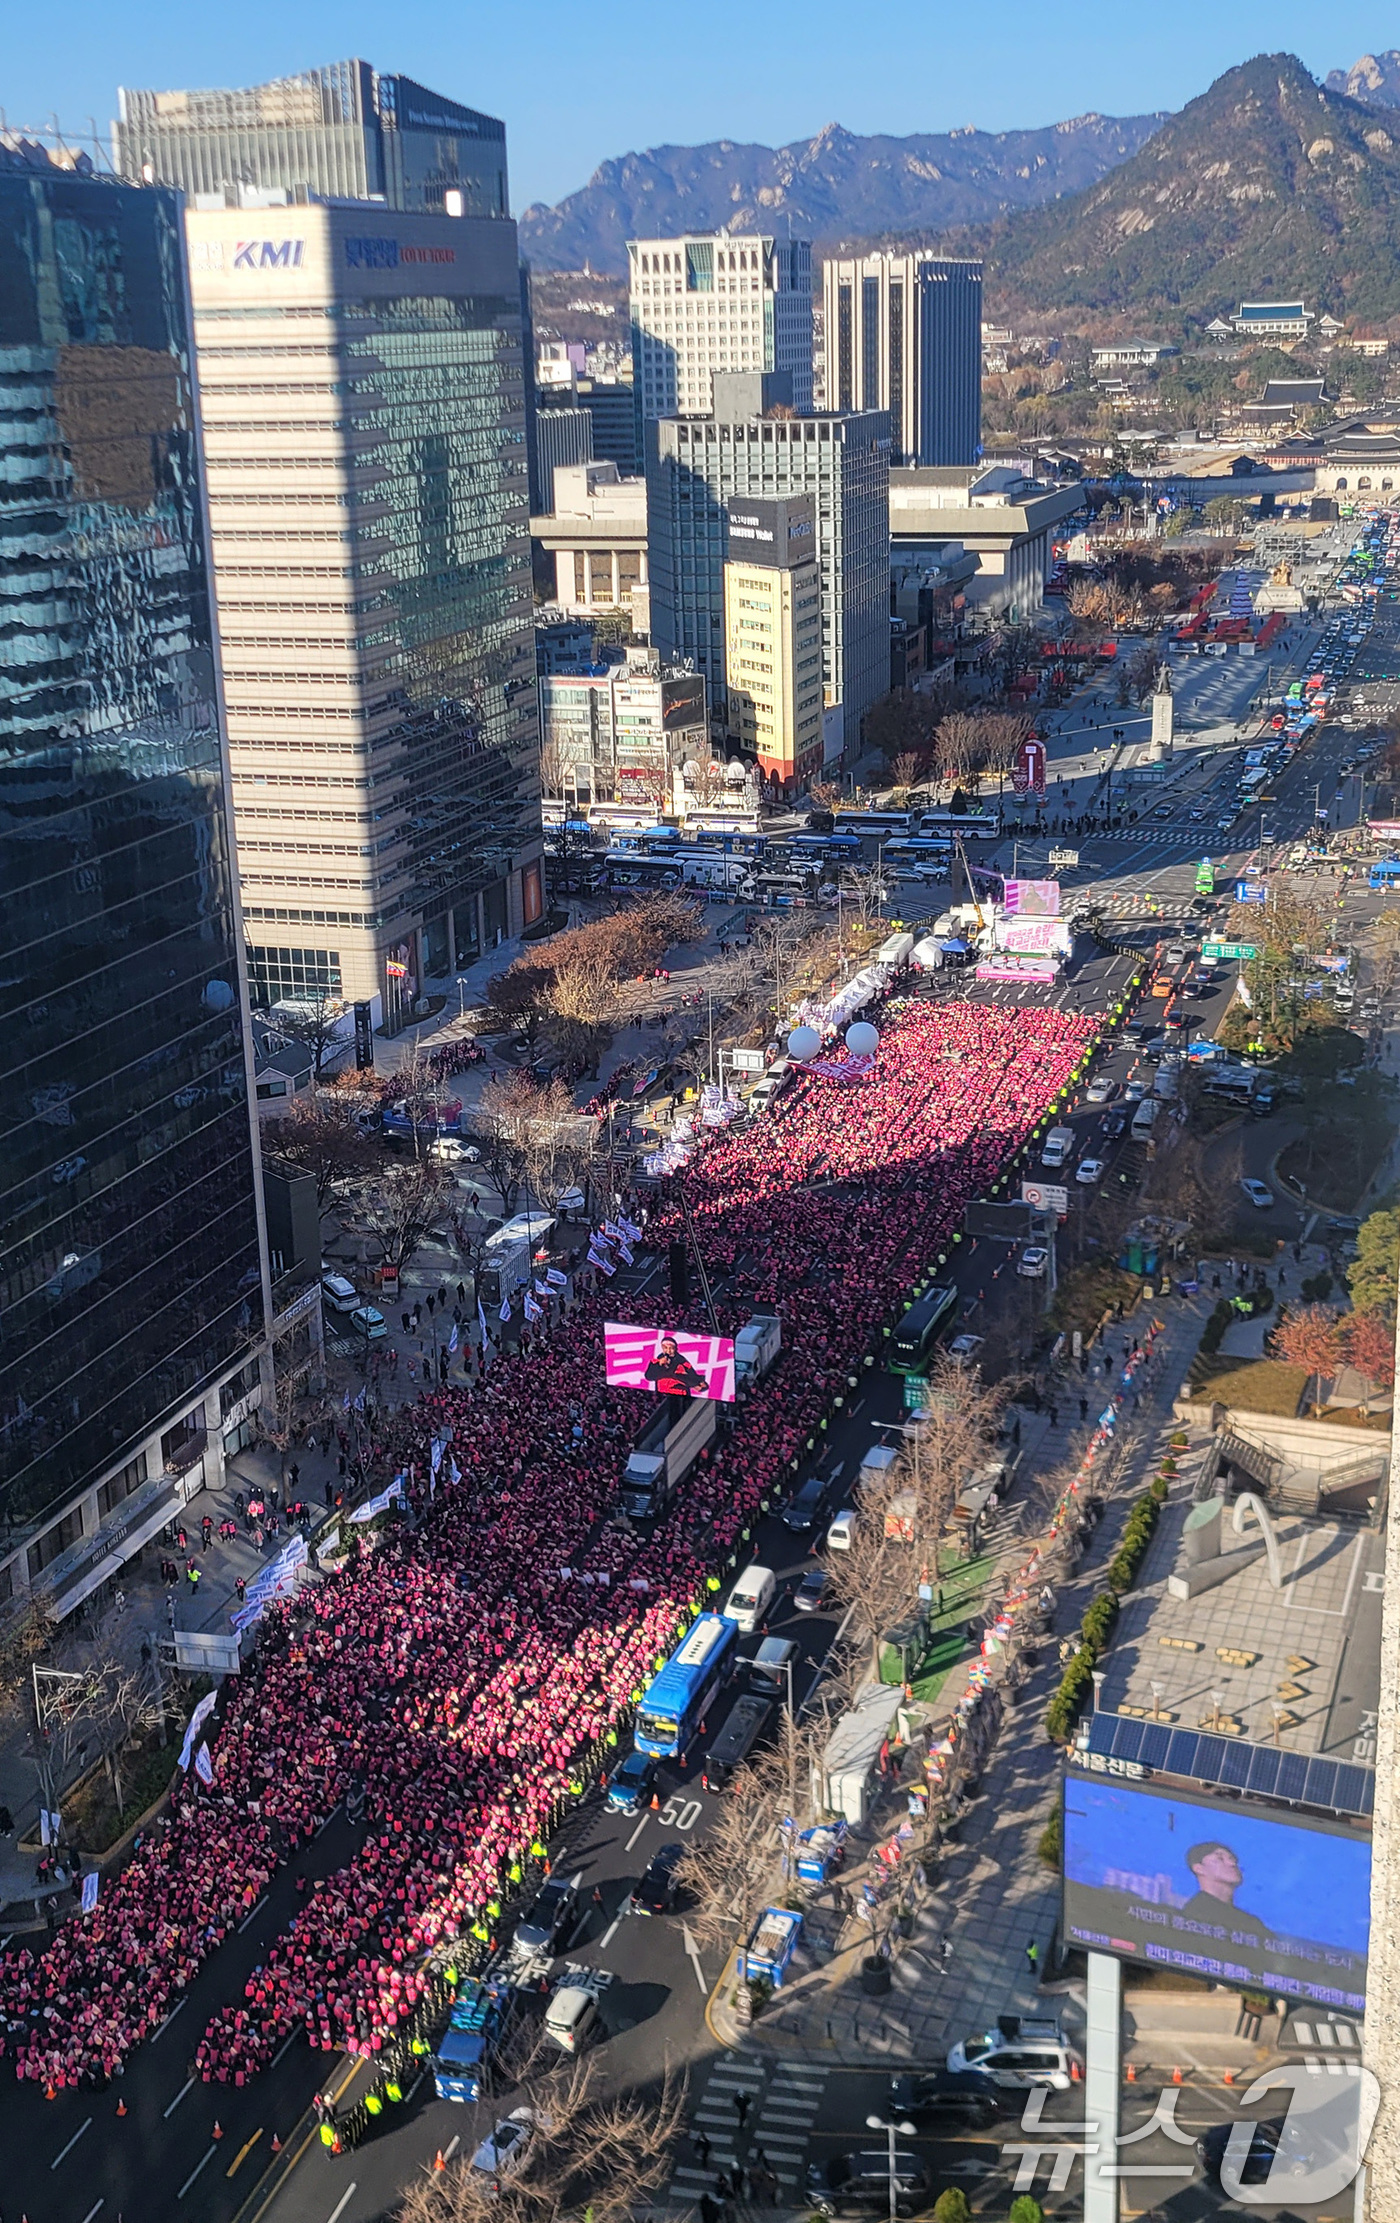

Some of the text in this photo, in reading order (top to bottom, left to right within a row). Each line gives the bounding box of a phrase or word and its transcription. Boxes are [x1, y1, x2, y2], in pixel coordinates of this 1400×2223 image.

[234, 241, 304, 268] KMI
[1070, 1749, 1145, 1781] 서울신문
[658, 1796, 703, 1831] 50
[1127, 1905, 1168, 1926] 시민의
[1325, 1951, 1353, 1971] 도시
